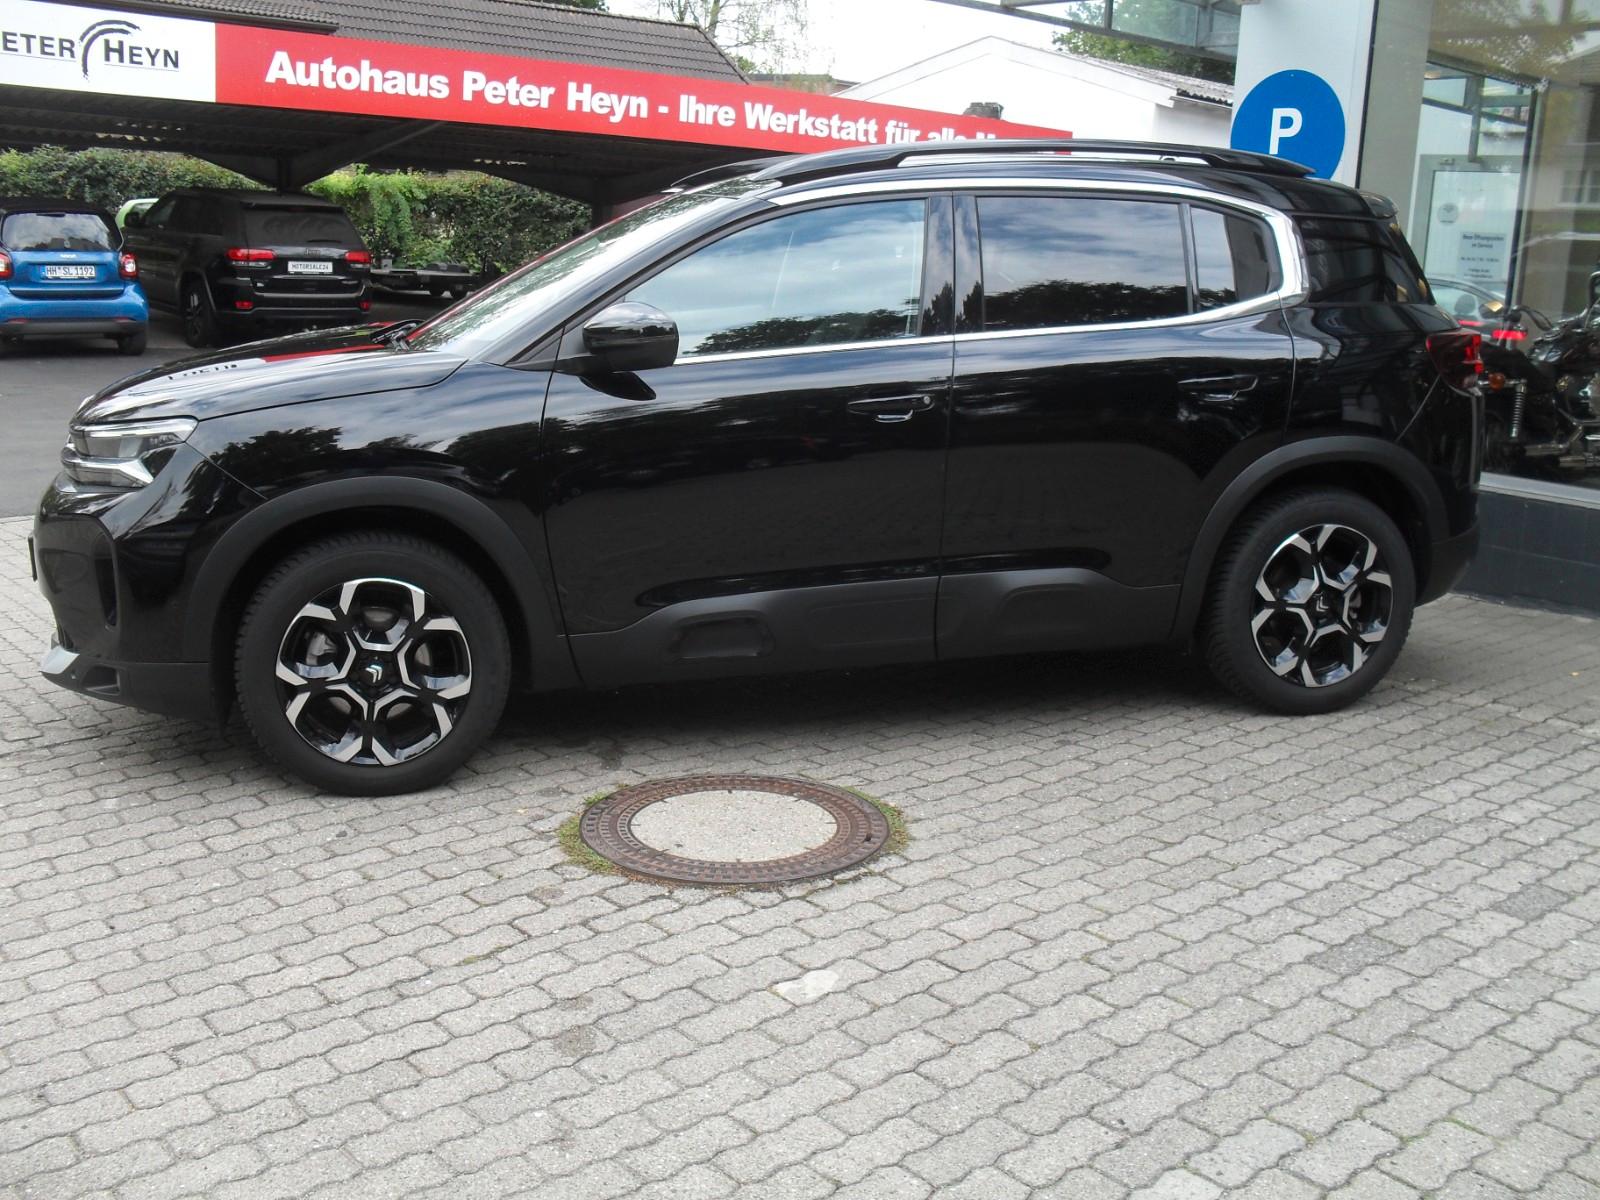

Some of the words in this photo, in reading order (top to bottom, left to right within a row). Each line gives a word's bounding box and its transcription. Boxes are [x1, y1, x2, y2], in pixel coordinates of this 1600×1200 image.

[1, 31, 76, 58] ETER
[103, 38, 179, 68] HEYN
[265, 50, 450, 99] Autohaus
[463, 70, 555, 108] Peter
[567, 82, 648, 123] Heyn
[679, 94, 736, 127] Ihre
[744, 102, 878, 143] Werkstatt
[885, 119, 920, 145] für
[1269, 107, 1303, 155] P
